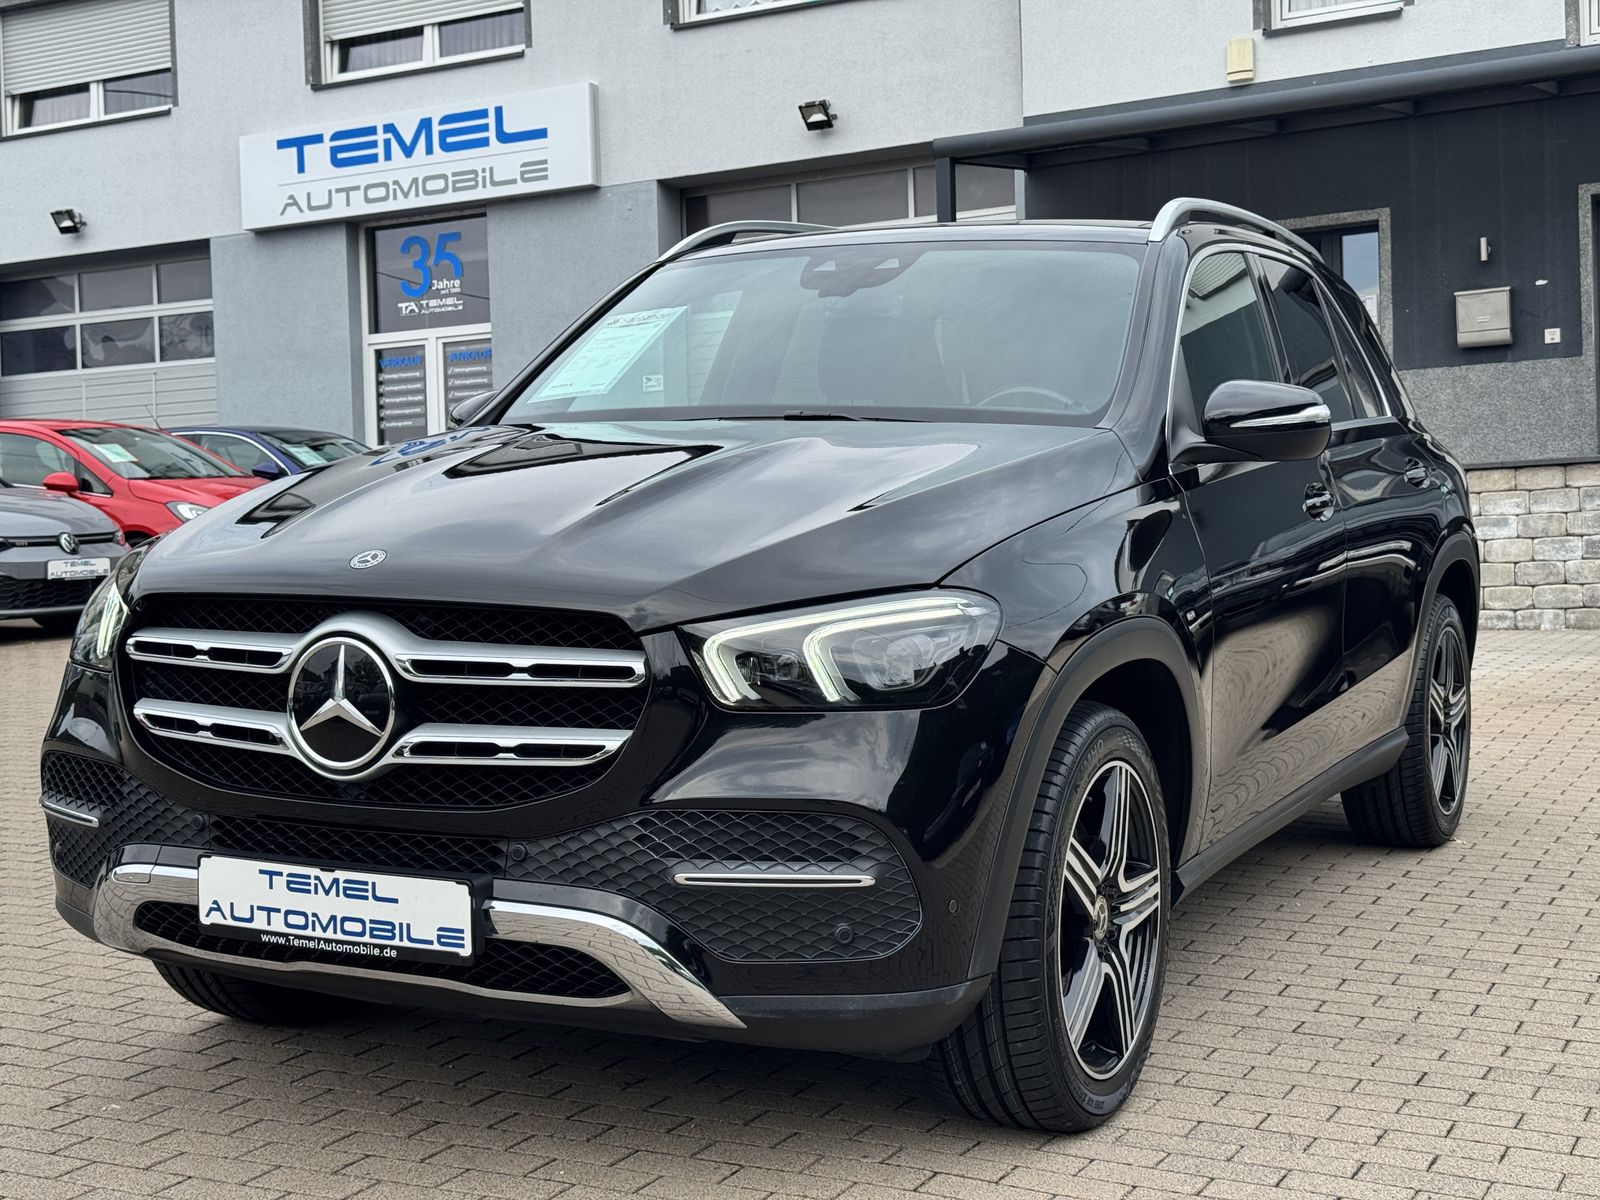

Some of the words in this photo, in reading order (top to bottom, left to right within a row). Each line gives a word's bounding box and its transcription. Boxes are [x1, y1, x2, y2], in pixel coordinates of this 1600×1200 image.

[276, 105, 548, 175] TEMEL
[400, 231, 463, 298] 35
[431, 278, 461, 291] Jahre
[420, 297, 464, 308] TEMEL
[49, 568, 109, 577] AUTOMOBILE
[258, 868, 399, 904] TEMEL
[205, 899, 466, 949] AUTOMOBILE
[260, 932, 398, 958] www.TemelAutomobile.de
